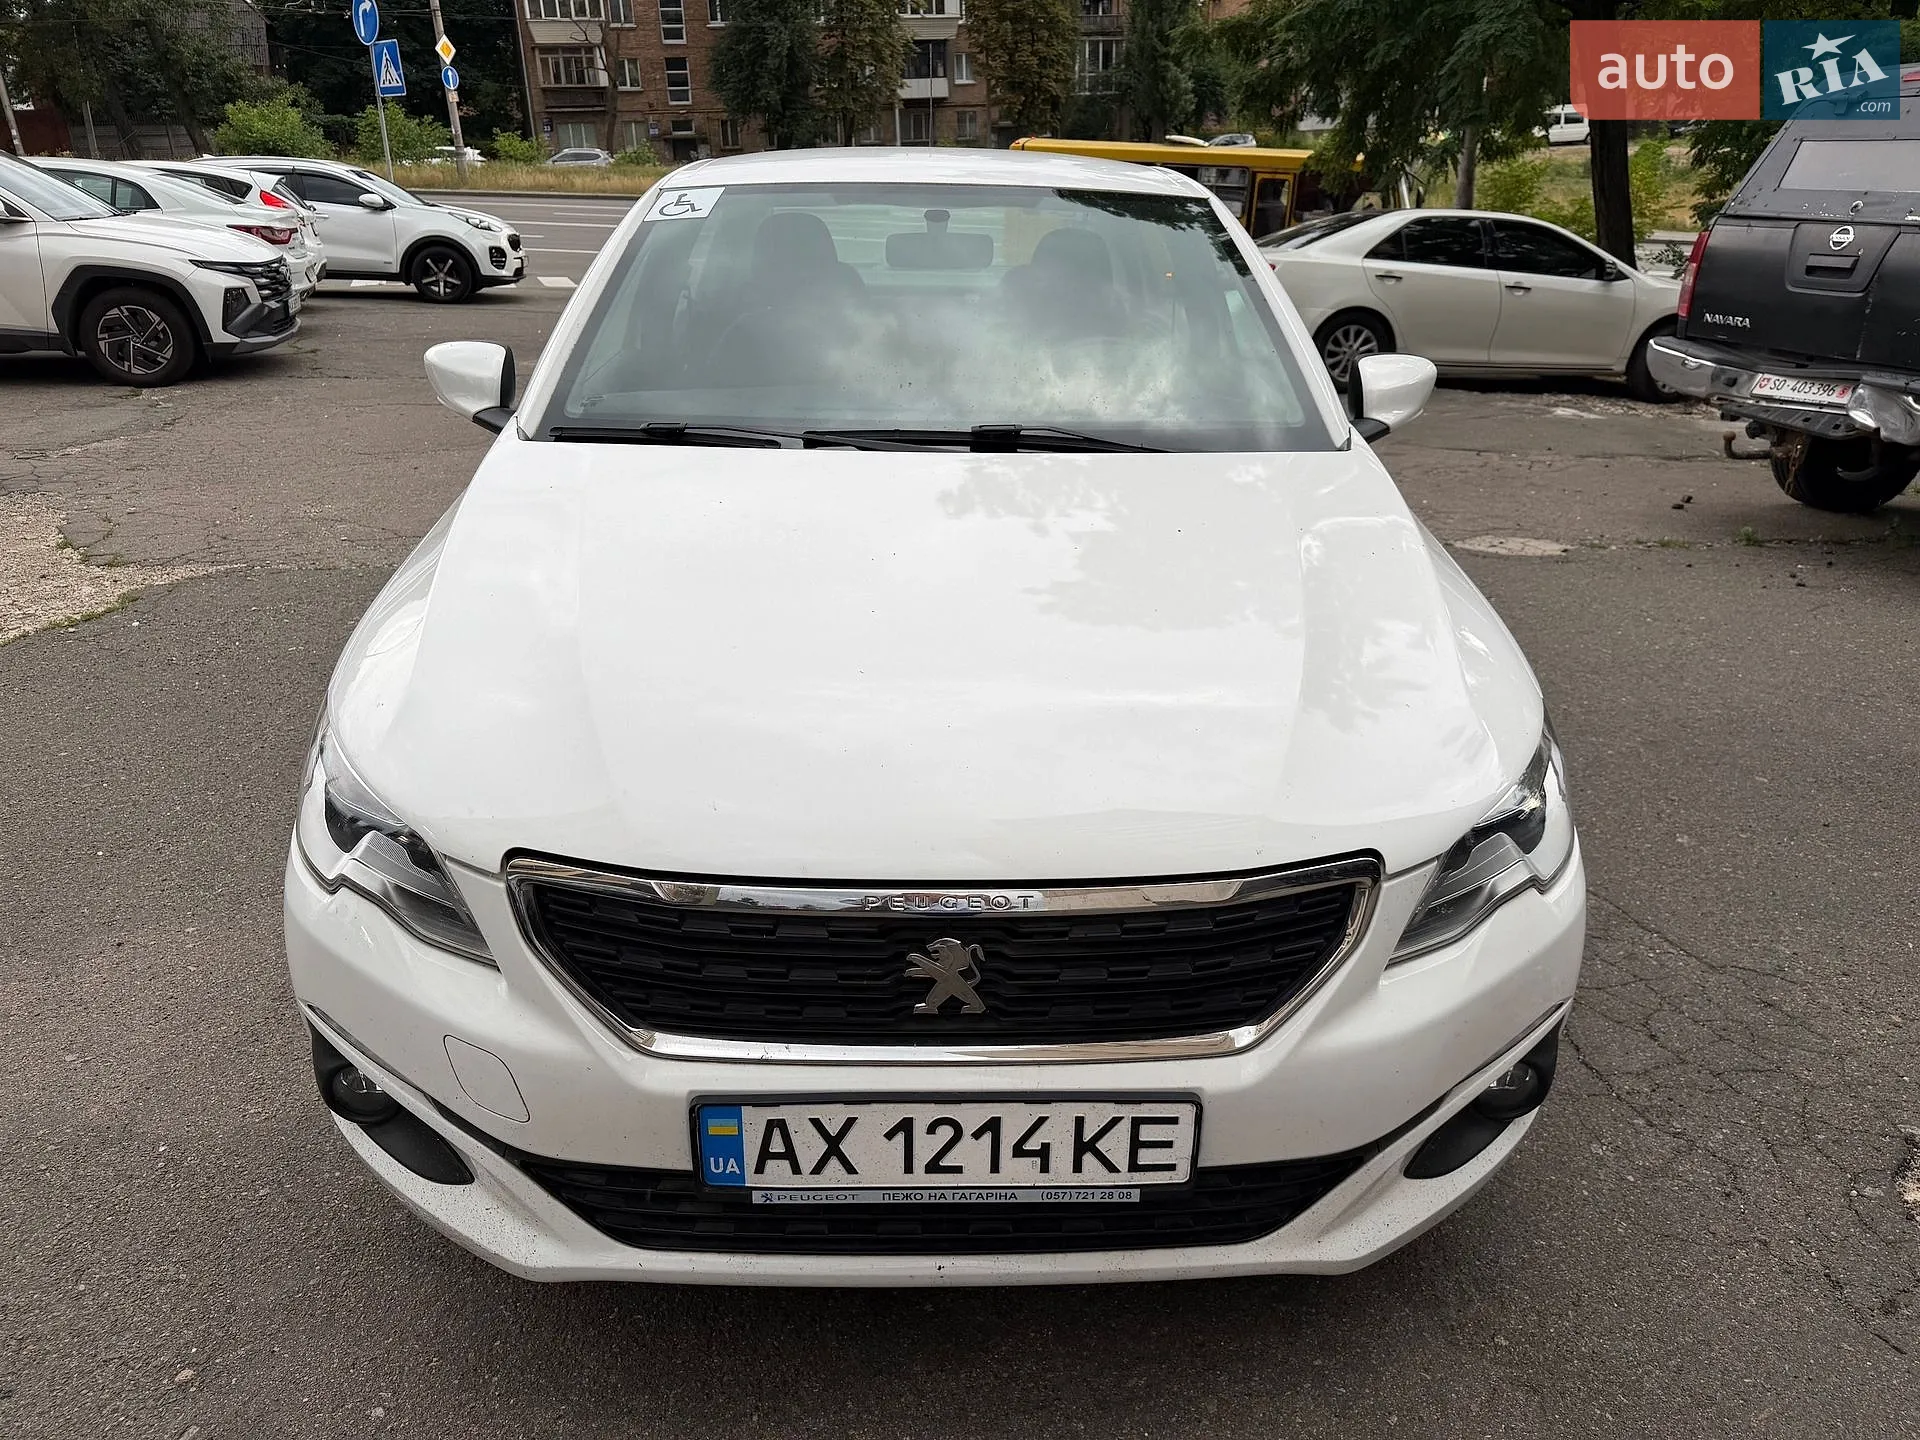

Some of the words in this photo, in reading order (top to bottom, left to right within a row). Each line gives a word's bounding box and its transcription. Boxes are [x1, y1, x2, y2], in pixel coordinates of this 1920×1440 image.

[1703, 312, 1751, 329] NAVARA
[863, 895, 1034, 911] PEUGEOT
[753, 1116, 860, 1176] AX
[883, 1115, 1051, 1175] 1214
[1071, 1115, 1180, 1174] KE
[709, 1157, 741, 1175] UA
[882, 1192, 924, 1201] ПЕЖО
[928, 1192, 948, 1201] НА
[952, 1192, 1018, 1201] ГАГАРІНА
[1099, 1191, 1114, 1200] 28
[1117, 1191, 1132, 1199] 08
